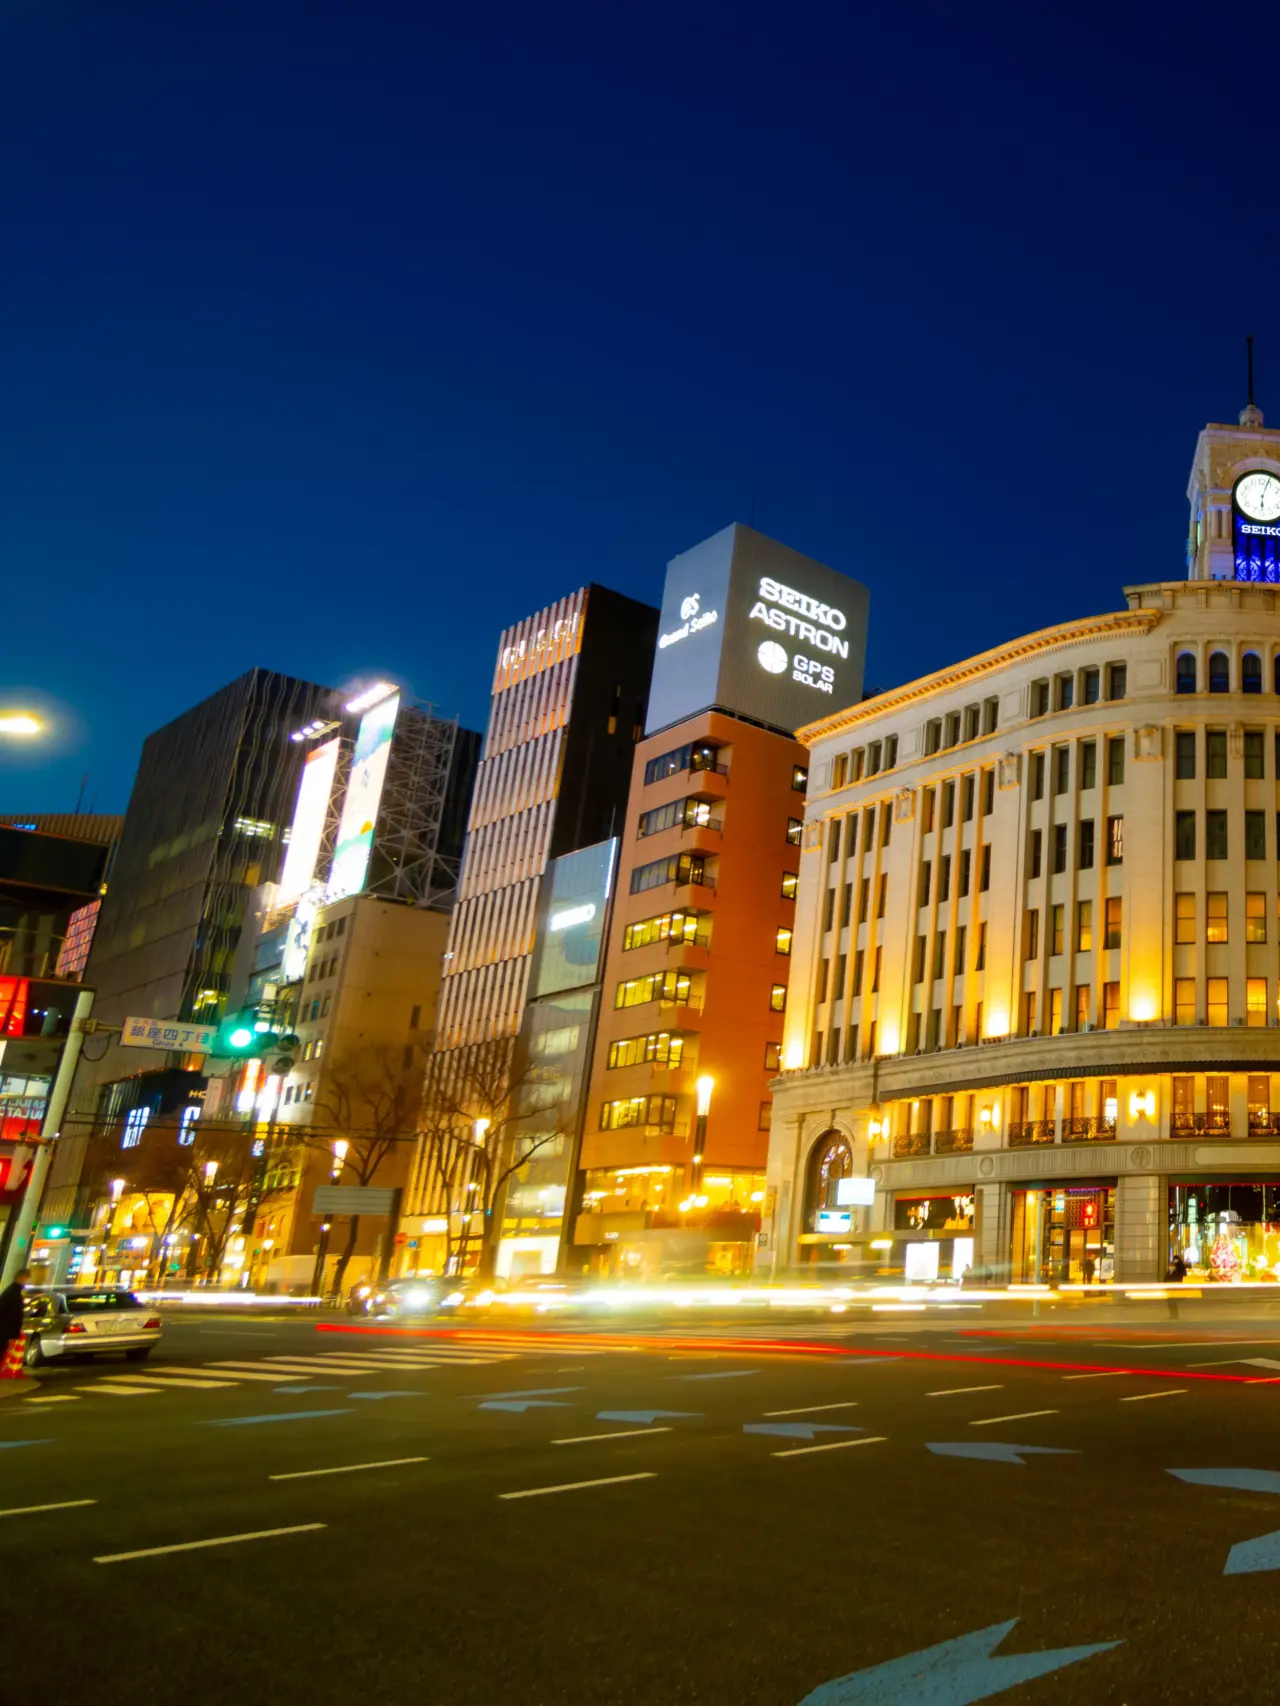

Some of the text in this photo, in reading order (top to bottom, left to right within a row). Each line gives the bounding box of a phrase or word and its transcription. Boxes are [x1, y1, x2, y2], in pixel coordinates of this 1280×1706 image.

[759, 577, 847, 631] SEIKO
[749, 601, 849, 659] ASTRON
[792, 669, 834, 695] SOLAR
[793, 654, 835, 683] GPS
[130, 1025, 210, 1045] 銀座四丁目
